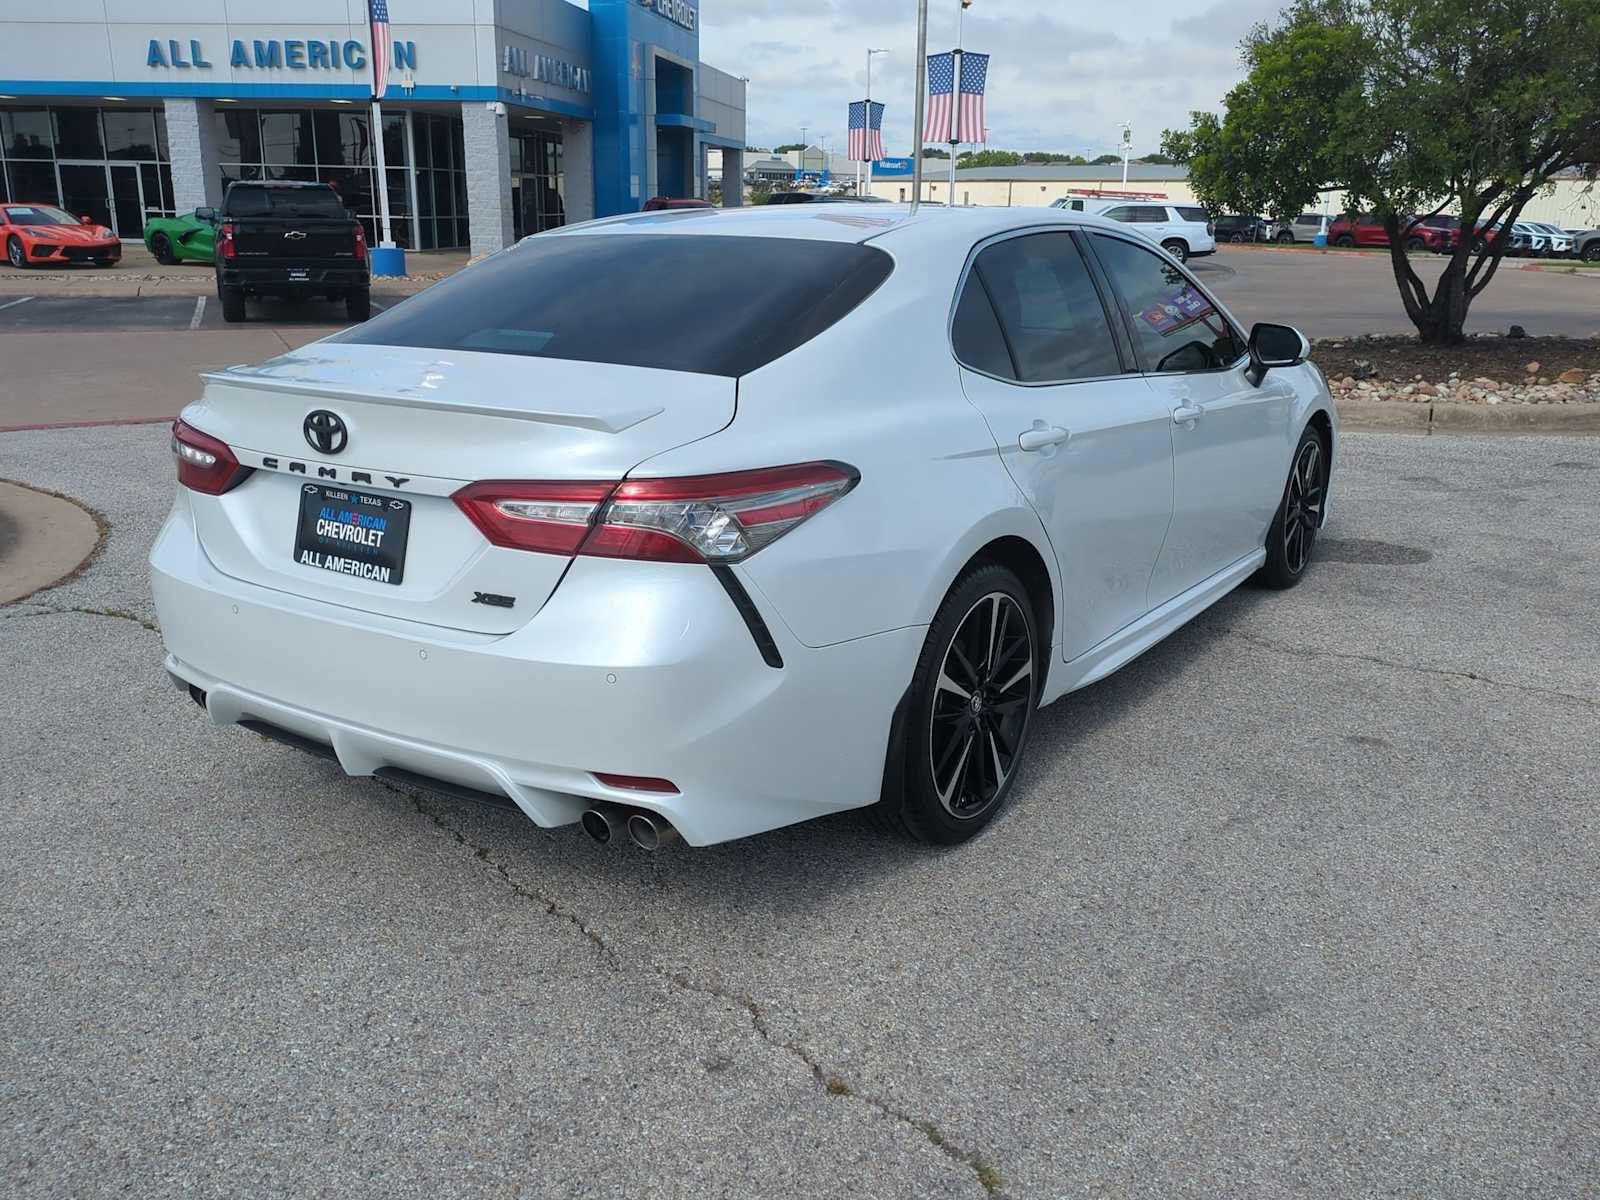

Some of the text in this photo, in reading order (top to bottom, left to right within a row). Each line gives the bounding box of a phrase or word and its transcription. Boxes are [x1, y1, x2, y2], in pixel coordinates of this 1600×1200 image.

[147, 39, 417, 70] ALL AMERICN
[263, 457, 410, 488] CAMRY
[325, 490, 381, 506] KILLEEN TEXAS
[316, 519, 384, 548] CHEVROLET
[319, 507, 387, 530] ALL AMERICAN
[300, 550, 390, 582] ALL AMERICAN
